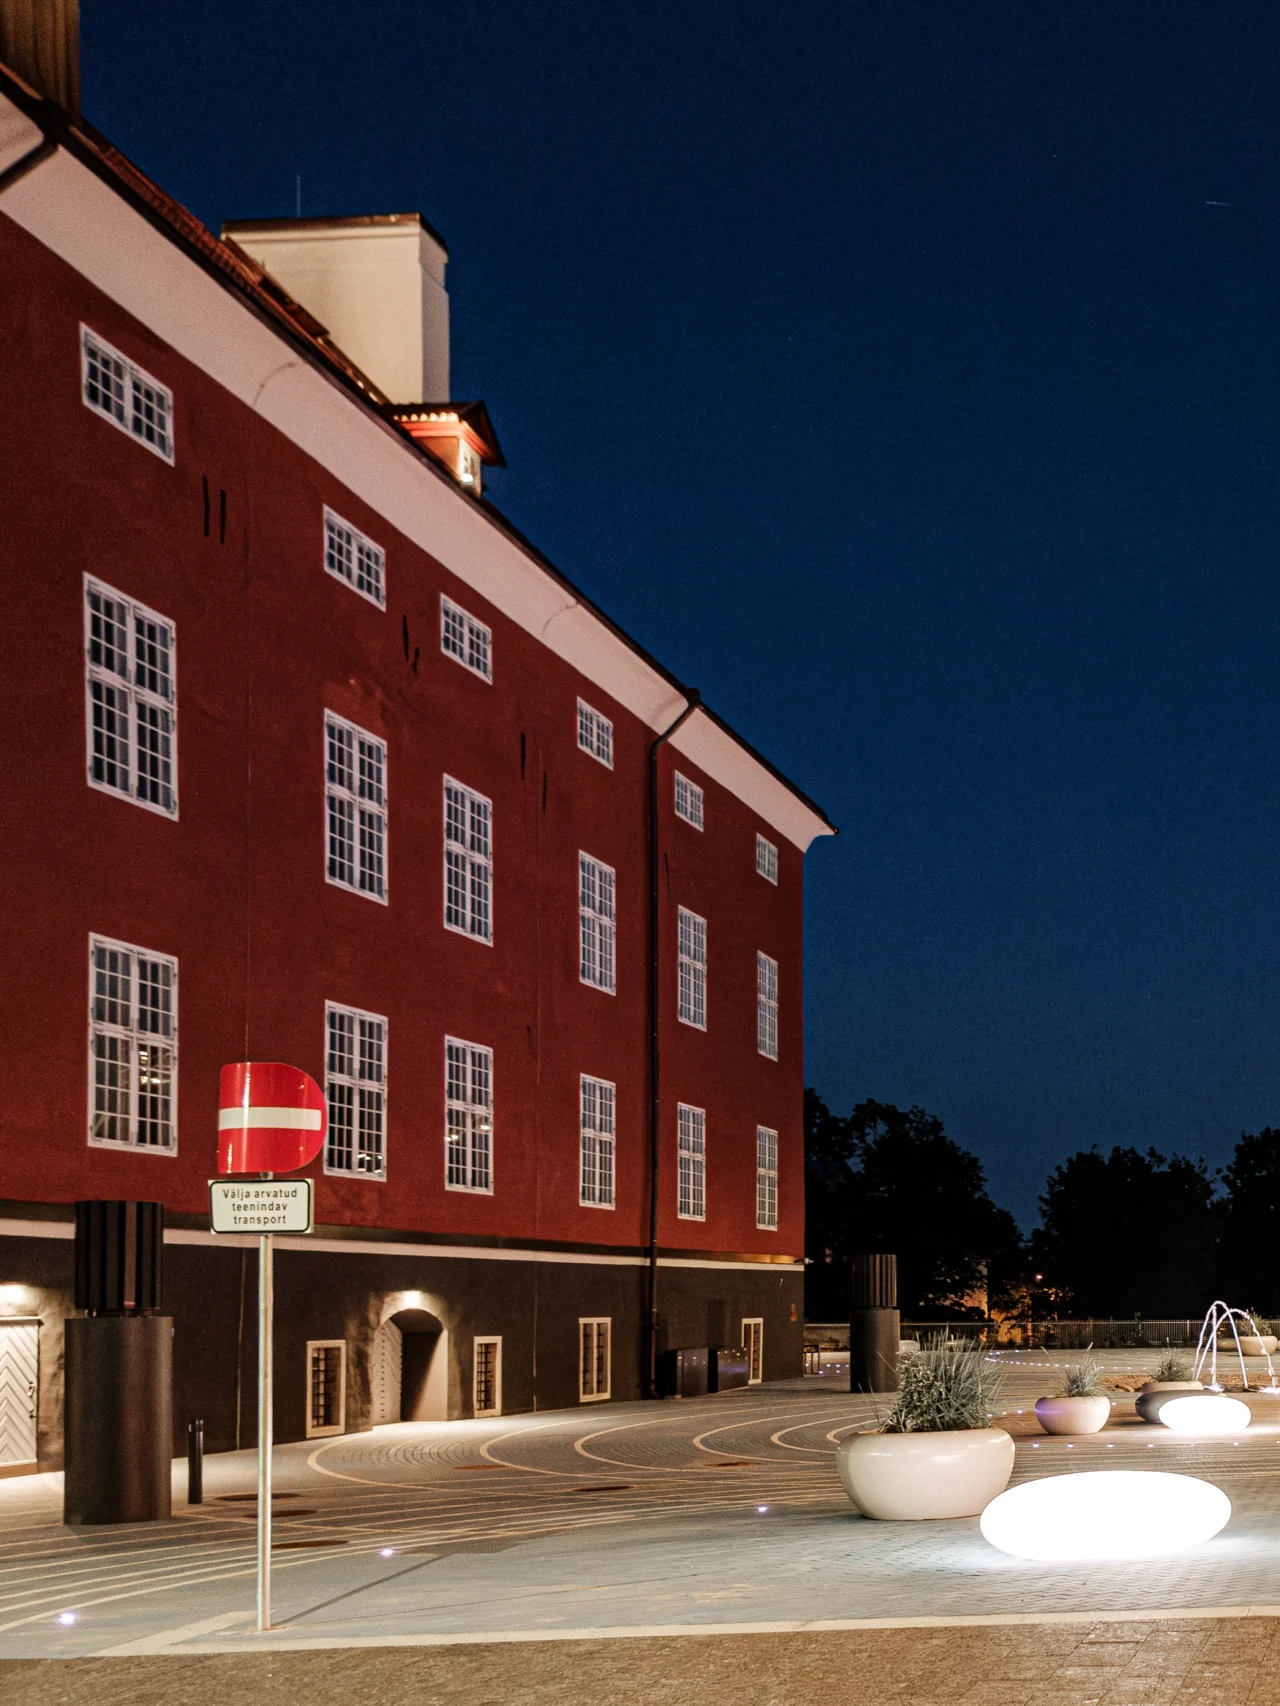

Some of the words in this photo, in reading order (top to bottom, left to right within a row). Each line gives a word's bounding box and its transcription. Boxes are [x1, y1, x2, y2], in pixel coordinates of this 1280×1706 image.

[222, 1189, 250, 1201] Välja
[254, 1188, 297, 1198] arvatud
[232, 1201, 287, 1211] teenindav
[234, 1215, 286, 1226] transport
